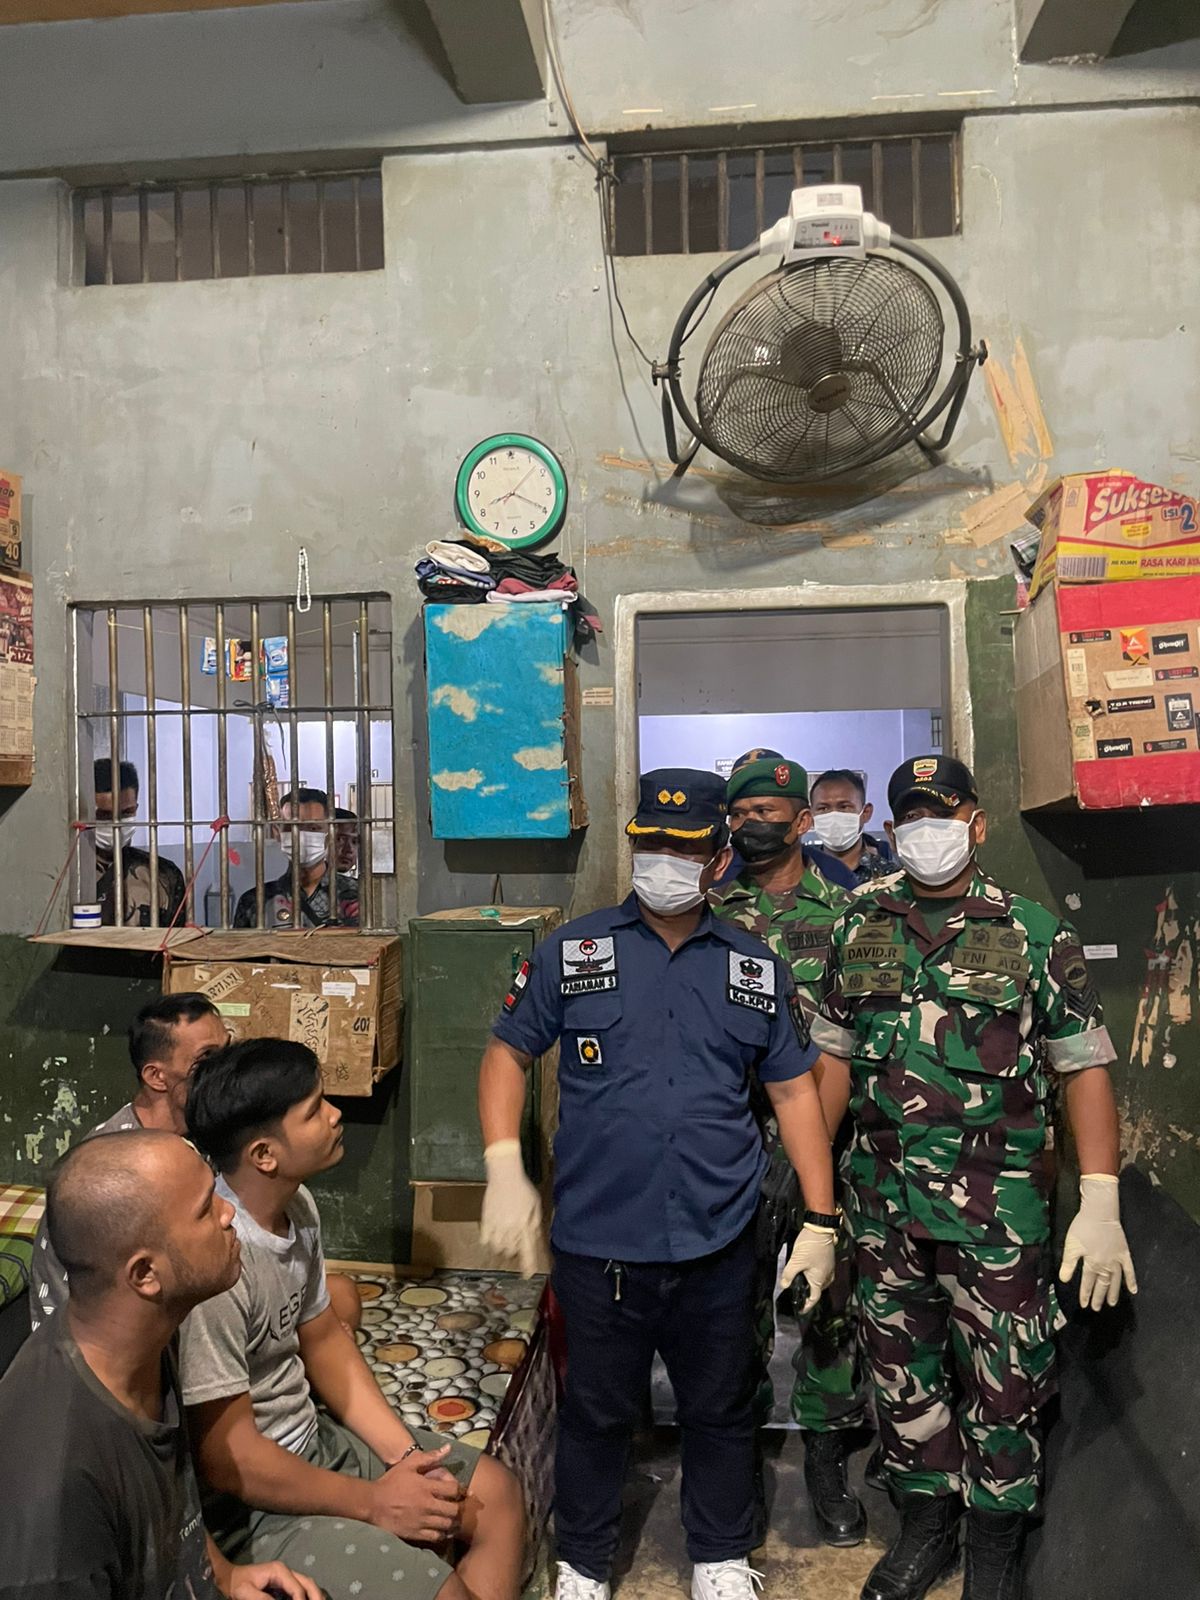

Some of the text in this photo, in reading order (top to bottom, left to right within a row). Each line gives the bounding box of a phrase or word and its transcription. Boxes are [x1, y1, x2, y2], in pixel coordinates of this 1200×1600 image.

[490, 457, 497, 465] 11
[476, 471, 486, 480] 10
[474, 489, 481, 498] 9
[546, 487, 552, 496] 3
[480, 508, 487, 517] 8
[1181, 503, 1196, 531] 2
[494, 522, 500, 530] 7
[530, 521, 536, 530] 5
[512, 527, 518, 535] 6
[1141, 558, 1164, 568] RASA
[1166, 557, 1186, 567] KARI
[848, 946, 897, 960] DAVID.R
[962, 951, 1021, 971] TNI AD
